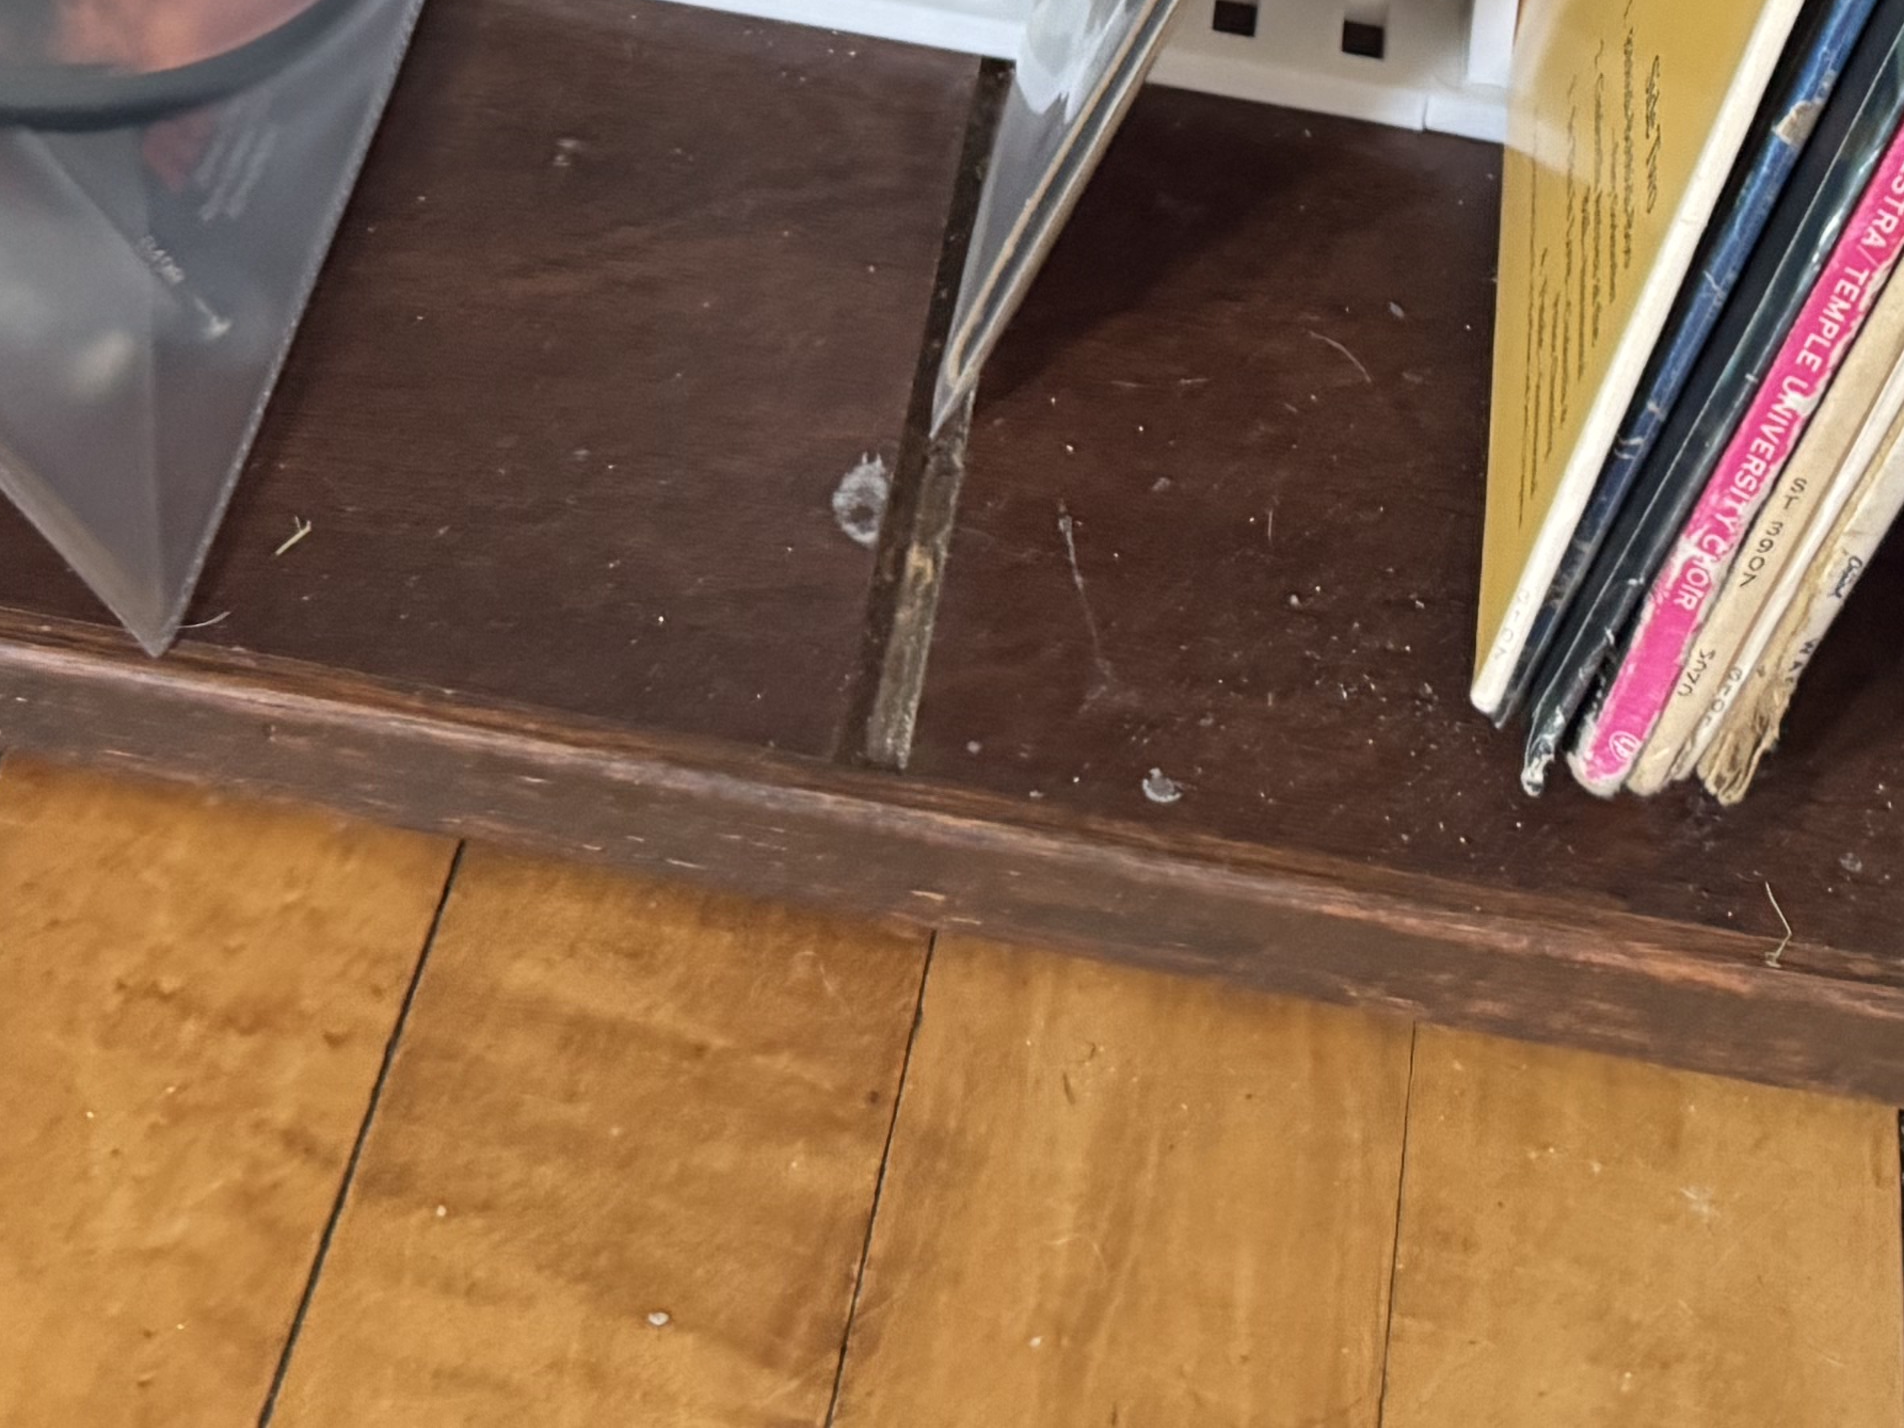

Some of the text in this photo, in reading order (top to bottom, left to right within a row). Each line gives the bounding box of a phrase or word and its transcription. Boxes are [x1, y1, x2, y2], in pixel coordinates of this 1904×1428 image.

[1793, 260, 1873, 375] TEMPLE
[1708, 372, 1815, 534] UNIVERSITY
[1667, 529, 1734, 616] CHOIR
